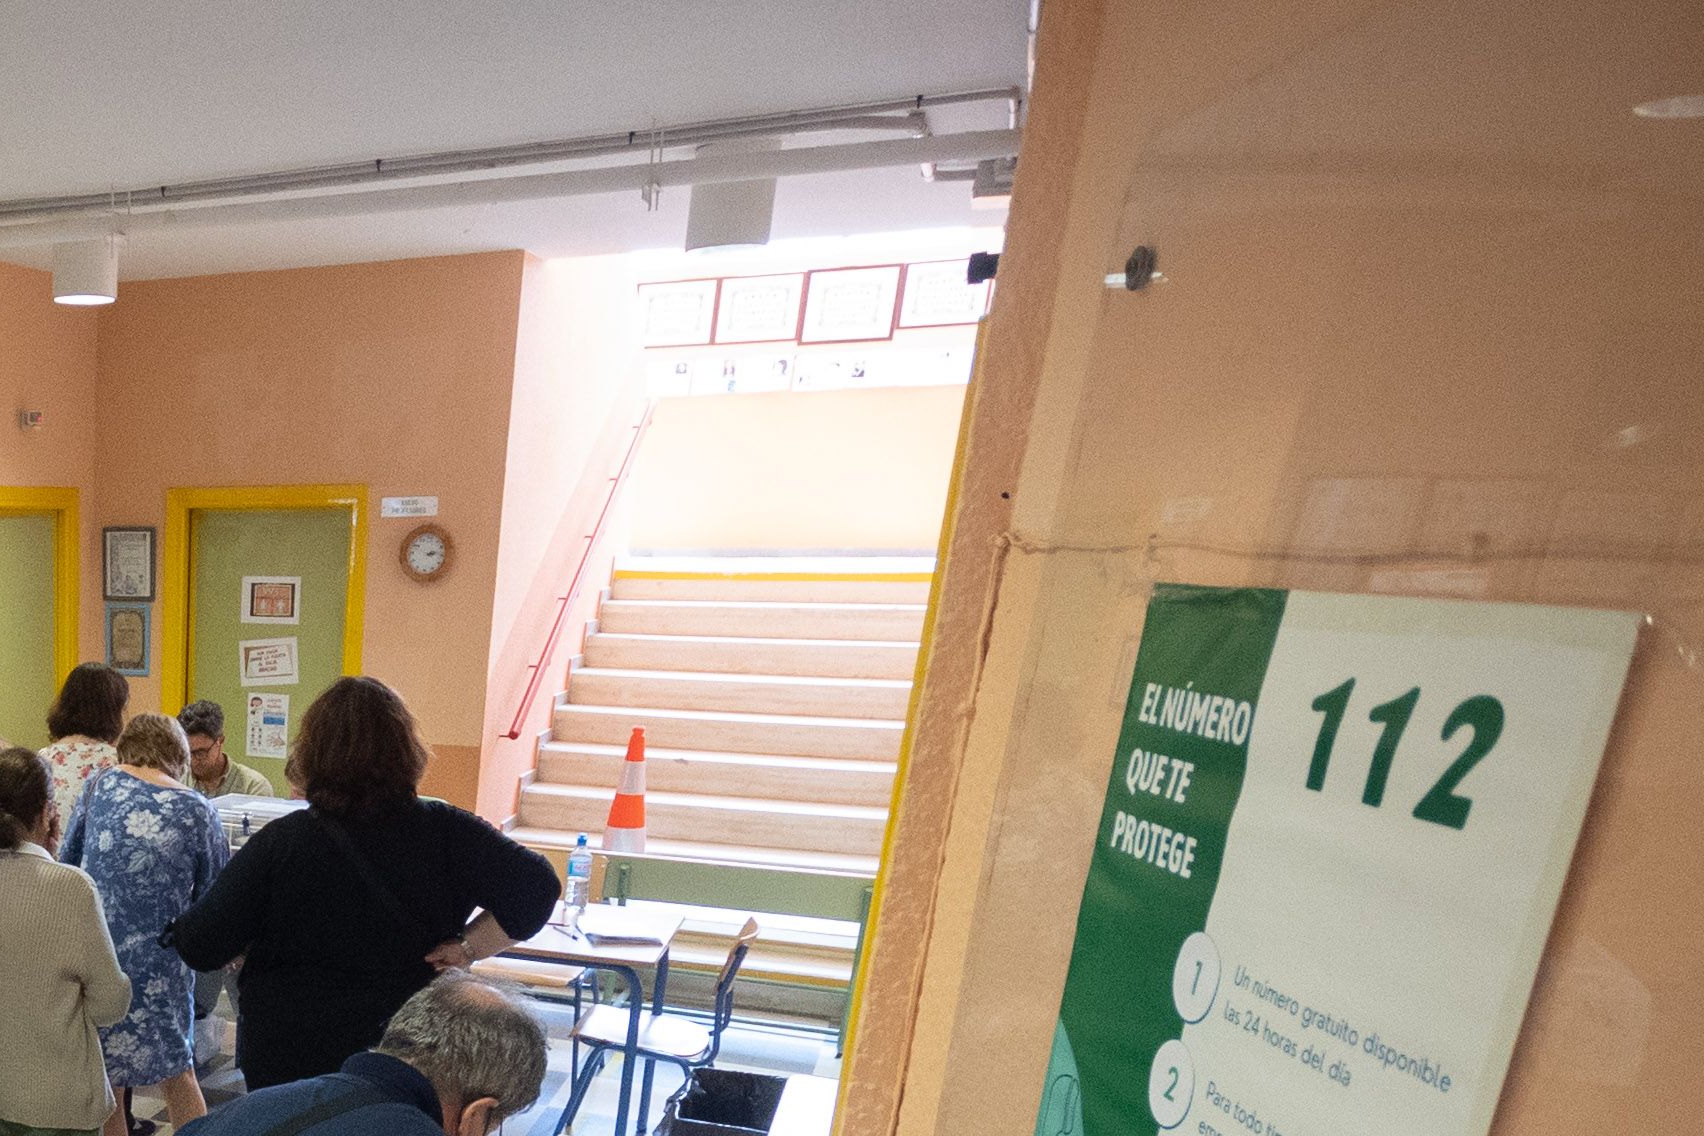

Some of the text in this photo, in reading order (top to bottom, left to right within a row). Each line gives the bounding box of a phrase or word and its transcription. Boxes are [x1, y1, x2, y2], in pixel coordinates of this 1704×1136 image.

[1138, 681, 1252, 746] EL NÚMERO
[1125, 748, 1195, 804] QUE TE
[1304, 676, 1505, 831] 112
[1110, 811, 1198, 879] PROTEGE
[1192, 961, 1204, 995] 1
[1224, 1001, 1352, 1088] las 24 horas del día
[1234, 965, 1453, 1094] Un número gratuito disponible
[1163, 1066, 1180, 1102] 2
[1206, 1081, 1232, 1114] Para
[1233, 1101, 1264, 1134] todo
